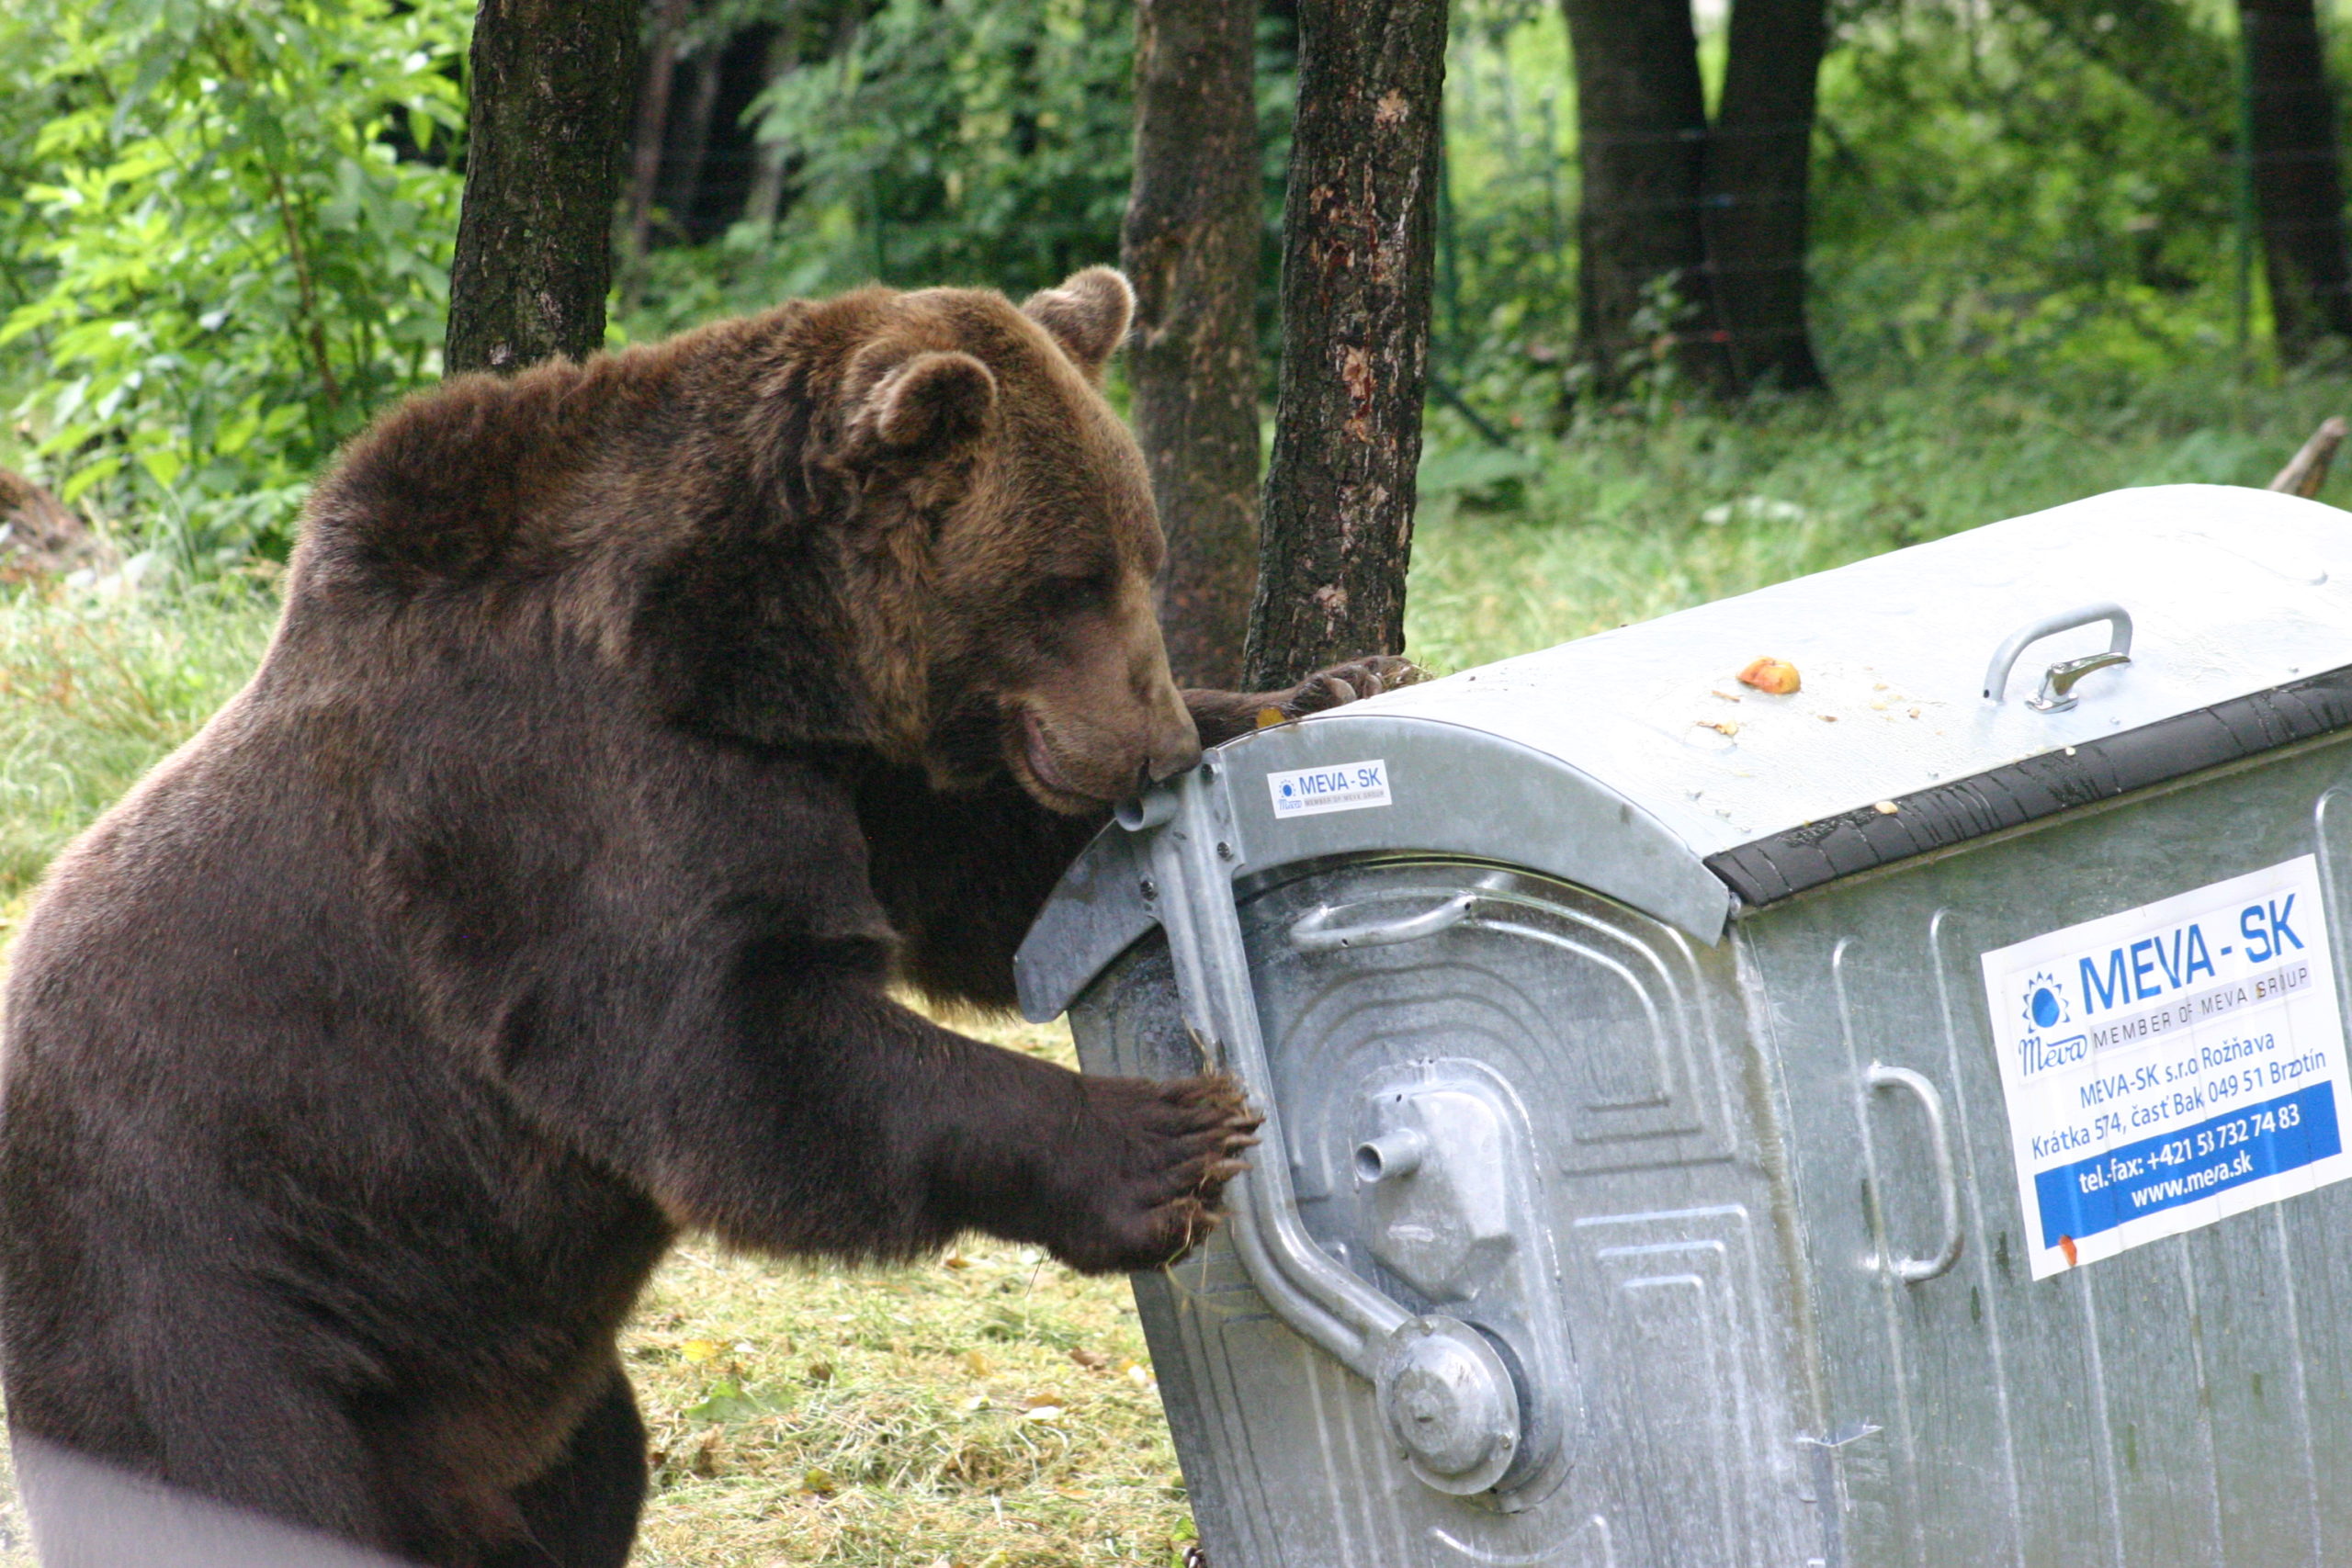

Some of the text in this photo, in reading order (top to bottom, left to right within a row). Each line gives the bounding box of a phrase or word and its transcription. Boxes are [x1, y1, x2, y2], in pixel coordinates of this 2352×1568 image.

[1299, 772, 1349, 795] MEVA
[1358, 767, 1382, 787] SK
[2079, 923, 2215, 1015] MEVA
[2240, 893, 2305, 964] SK
[2094, 1012, 2172, 1048] MEMBER
[2178, 1003, 2193, 1022] OF
[2201, 987, 2248, 1015] MEVA
[2080, 1032, 2275, 1109] MEVA-SK s.r.o Rožňava
[2031, 1125, 2091, 1160] Krátka
[2132, 1095, 2170, 1128] časť
[2173, 1086, 2205, 1116] Bak
[2208, 1074, 2239, 1103] 049
[2244, 1067, 2264, 1092] 51
[2146, 1138, 2192, 1170] +421
[2216, 1119, 2249, 1149] 732
[2251, 1111, 2276, 1138] 74
[2278, 1103, 2301, 1129] 83
